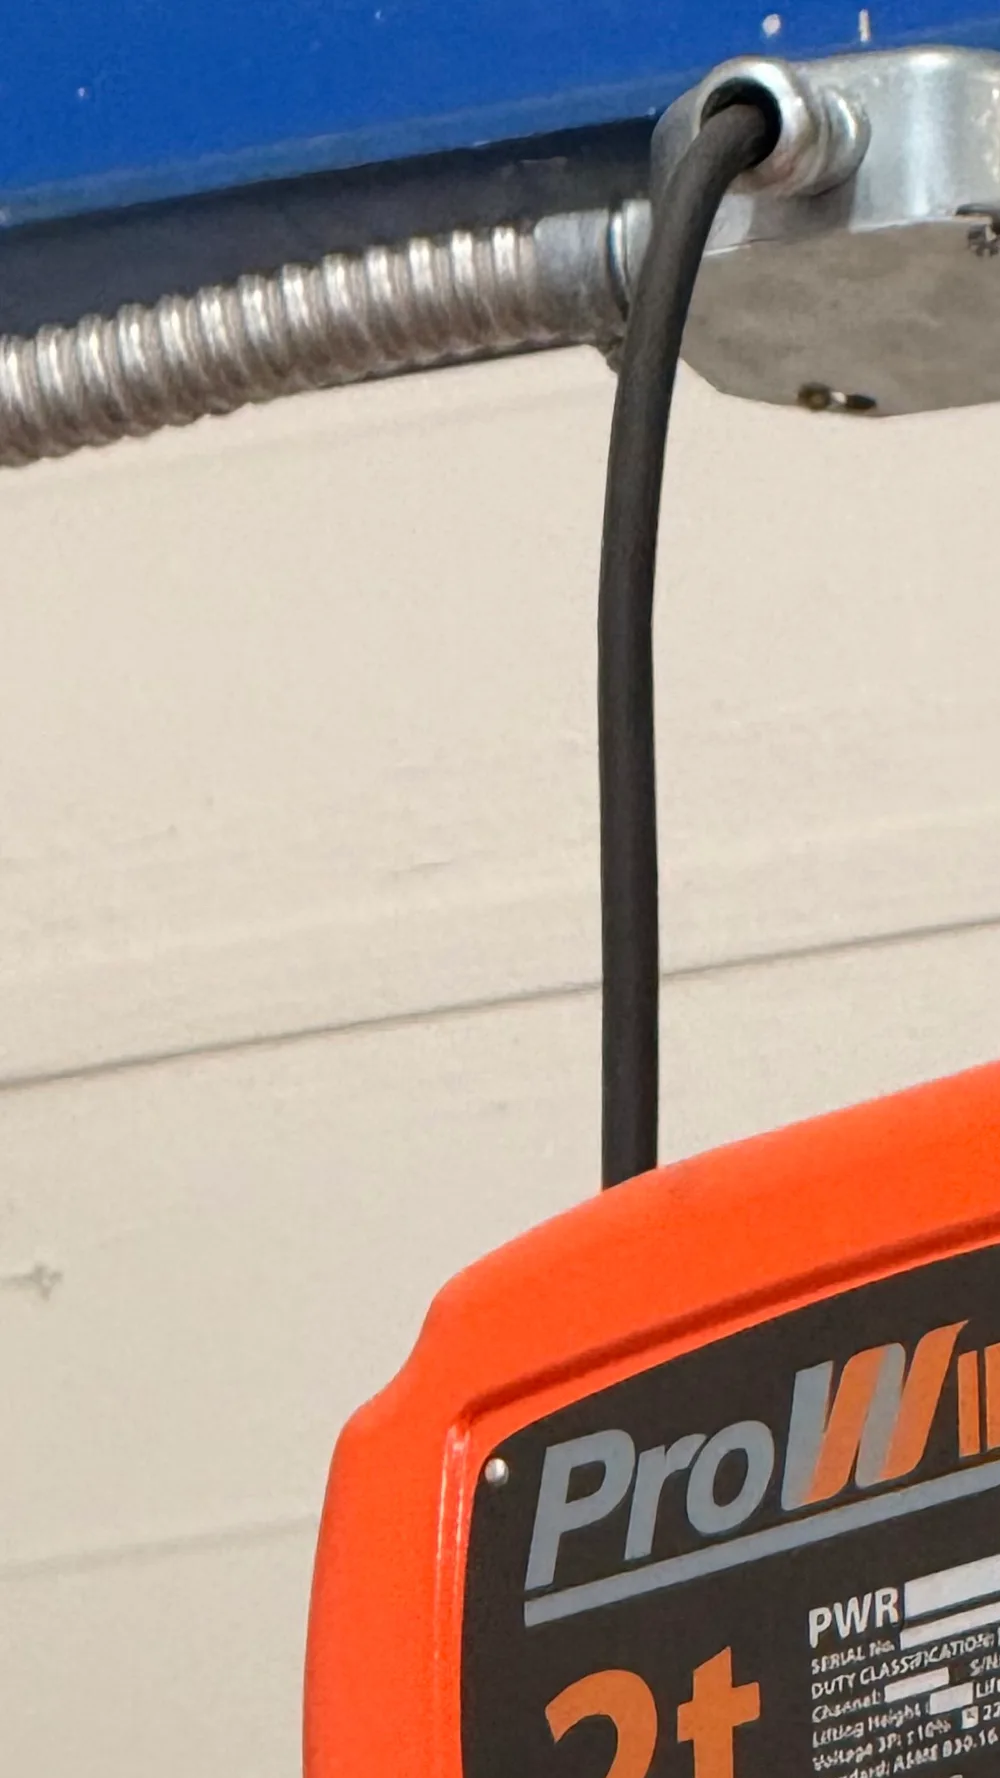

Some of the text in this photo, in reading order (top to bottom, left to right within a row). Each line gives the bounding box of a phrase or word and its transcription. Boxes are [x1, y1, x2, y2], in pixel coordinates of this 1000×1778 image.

[808, 1586, 899, 1649] PWR
[811, 1645, 866, 1675] SERIAL
[811, 1672, 856, 1700] DUTY
